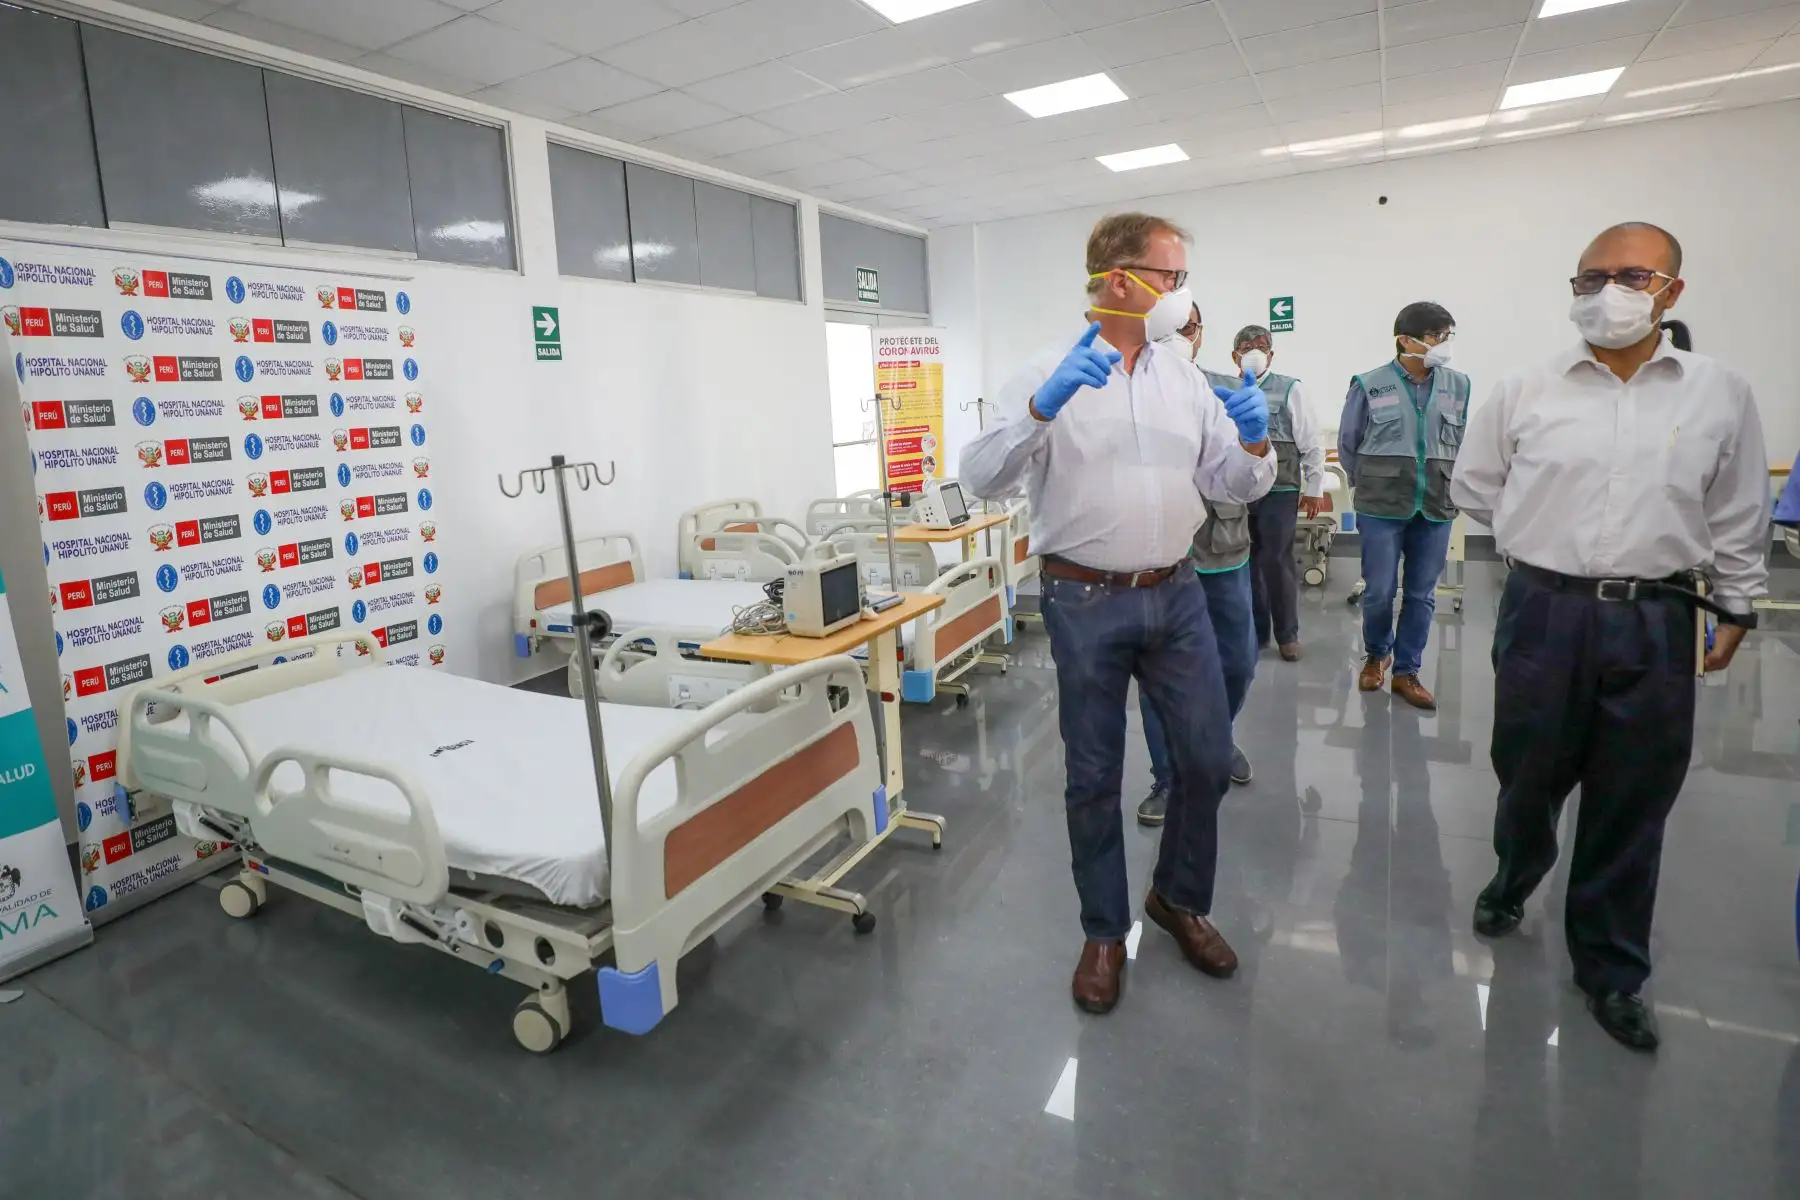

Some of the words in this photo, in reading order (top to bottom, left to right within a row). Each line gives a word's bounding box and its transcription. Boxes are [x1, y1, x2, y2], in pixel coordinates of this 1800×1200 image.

[14, 262, 53, 275] HOSPITAL
[54, 266, 96, 277] NACIONAL
[18, 273, 56, 283] HIPOLITO
[59, 275, 93, 286] UNANUE
[149, 280, 163, 288] PERÚ
[172, 277, 208, 288] Ministerio
[858, 270, 878, 292] SALIDA
[184, 287, 204, 296] Salud
[248, 283, 275, 291] HOSPITAL
[276, 285, 305, 294] NACIONAL
[252, 291, 278, 300] HIPOLITO
[280, 292, 303, 301] UNANUE
[358, 292, 384, 301] Ministerio
[25, 318, 43, 327] PERÚ
[55, 313, 99, 324] Ministerio
[147, 316, 180, 326] HOSPITAL
[181, 318, 215, 327] NACIONAL
[56, 323, 67, 332] de
[70, 324, 95, 333] Salud
[152, 326, 184, 334] HIPOLITO
[186, 327, 213, 335] UNANUE
[277, 324, 307, 332] Ministerio
[286, 332, 304, 340] Salud
[538, 348, 561, 356] SALIDA
[879, 347, 939, 356] CORONAVIRUS
[25, 358, 65, 367] HOSPITAL
[68, 358, 108, 366] NACIONAL
[182, 361, 218, 369] Ministerio
[257, 360, 283, 368] HOSPITAL
[285, 360, 314, 368] NACIONAL
[366, 362, 391, 370] Ministerio
[31, 367, 70, 376] HIPOLITO
[73, 367, 105, 376] UNANUE
[194, 369, 214, 377] Salud
[288, 368, 311, 376] UNANUE
[159, 401, 189, 409] HOSPITAL
[192, 400, 225, 408] NACIONAL
[285, 399, 315, 407] Ministerio
[69, 404, 110, 414] Ministerio
[163, 409, 192, 418] HIPOLITO
[194, 408, 222, 416] UNANUE
[294, 406, 312, 414] Salud
[39, 411, 58, 420] PERÚ
[70, 415, 81, 423] de
[83, 414, 106, 423] Salud
[293, 434, 321, 442] NACIONAL
[193, 442, 228, 450] Ministerio
[269, 443, 294, 451] HIPOLITO
[296, 441, 319, 449] UNANUE
[39, 450, 79, 460] HOSPITAL
[82, 447, 119, 457] NACIONAL
[204, 450, 224, 458] Salud
[45, 458, 85, 469] HIPOLITO
[86, 457, 116, 466] UNANUE
[293, 472, 323, 480] Ministerio
[381, 469, 402, 477] UNANUE
[170, 482, 202, 492] HOSPITAL
[202, 479, 234, 488] NACIONAL
[302, 479, 319, 487] Salud
[83, 492, 122, 503] Ministerio
[174, 491, 204, 500] HIPOLITO
[206, 487, 232, 496] UNANUE
[96, 501, 118, 511] Salud
[378, 497, 405, 505] Ministerio
[53, 502, 72, 512] PERÚ
[274, 509, 299, 518] HOSPITAL
[301, 506, 328, 514] NACIONAL
[278, 517, 303, 525] HIPOLITO
[304, 514, 327, 522] UNANUE
[203, 520, 237, 530] Ministerio
[182, 529, 194, 538] PERÚ
[214, 528, 233, 537] Salud
[360, 532, 383, 540] HOSPITAL
[384, 528, 410, 536] NACIONAL
[53, 538, 94, 550] HOSPITAL
[95, 533, 131, 544] NACIONAL
[362, 538, 386, 546] HIPOLITO
[387, 534, 408, 543] UNANUE
[59, 546, 99, 559] HIPOLITO
[100, 543, 129, 553] UNANUE
[302, 542, 330, 552] Ministerio
[311, 550, 327, 559] Salud
[181, 562, 211, 573] HOSPITAL
[213, 556, 244, 567] NACIONAL
[383, 561, 411, 570] Ministerio
[185, 570, 214, 580] HIPOLITO
[215, 565, 242, 575] UNANUE
[392, 568, 408, 576] Salud
[96, 577, 135, 590] Ministerio
[283, 583, 308, 592] HOSPITAL
[309, 575, 336, 586] NACIONAL
[68, 589, 85, 600] PERÚ
[109, 587, 131, 598] Salud
[286, 589, 311, 598] HIPOLITO
[312, 583, 334, 593] UNANUE
[214, 596, 247, 608] Ministerio
[368, 598, 389, 607] HOSPITAL
[390, 592, 415, 602] NACIONAL
[224, 605, 244, 615] Salud
[370, 605, 391, 613] HIPOLITO
[393, 600, 413, 608] UNANUE
[193, 608, 205, 618] PERÚ
[309, 612, 337, 623] Ministerio
[67, 625, 106, 639] HOSPITAL
[108, 617, 144, 632] NACIONAL
[319, 620, 334, 629] Salud
[388, 625, 415, 635] Ministerio
[73, 634, 111, 647] HIPOLITO
[112, 626, 141, 639] UNANUE
[192, 640, 222, 653] HOSPITAL
[222, 631, 254, 644] NACIONAL
[196, 648, 225, 660] HIPOLITO
[227, 639, 251, 651] UNANUE
[110, 661, 147, 675] Ministerio
[122, 669, 143, 682] Salud
[82, 677, 99, 687] PERÚ
[87, 718, 118, 733] HIPOLIT
[96, 760, 112, 772] PERÚ
[0, 763, 35, 784] ALUD
[134, 819, 172, 839] Ministerio
[147, 828, 168, 843] Salud
[110, 843, 126, 854] PERÚ
[110, 871, 144, 890] HOSPITAL
[146, 854, 181, 875] NACIONAL
[115, 878, 148, 898] HIPOLITO
[150, 864, 179, 882] UNANUE
[40, 889, 52, 897] DE
